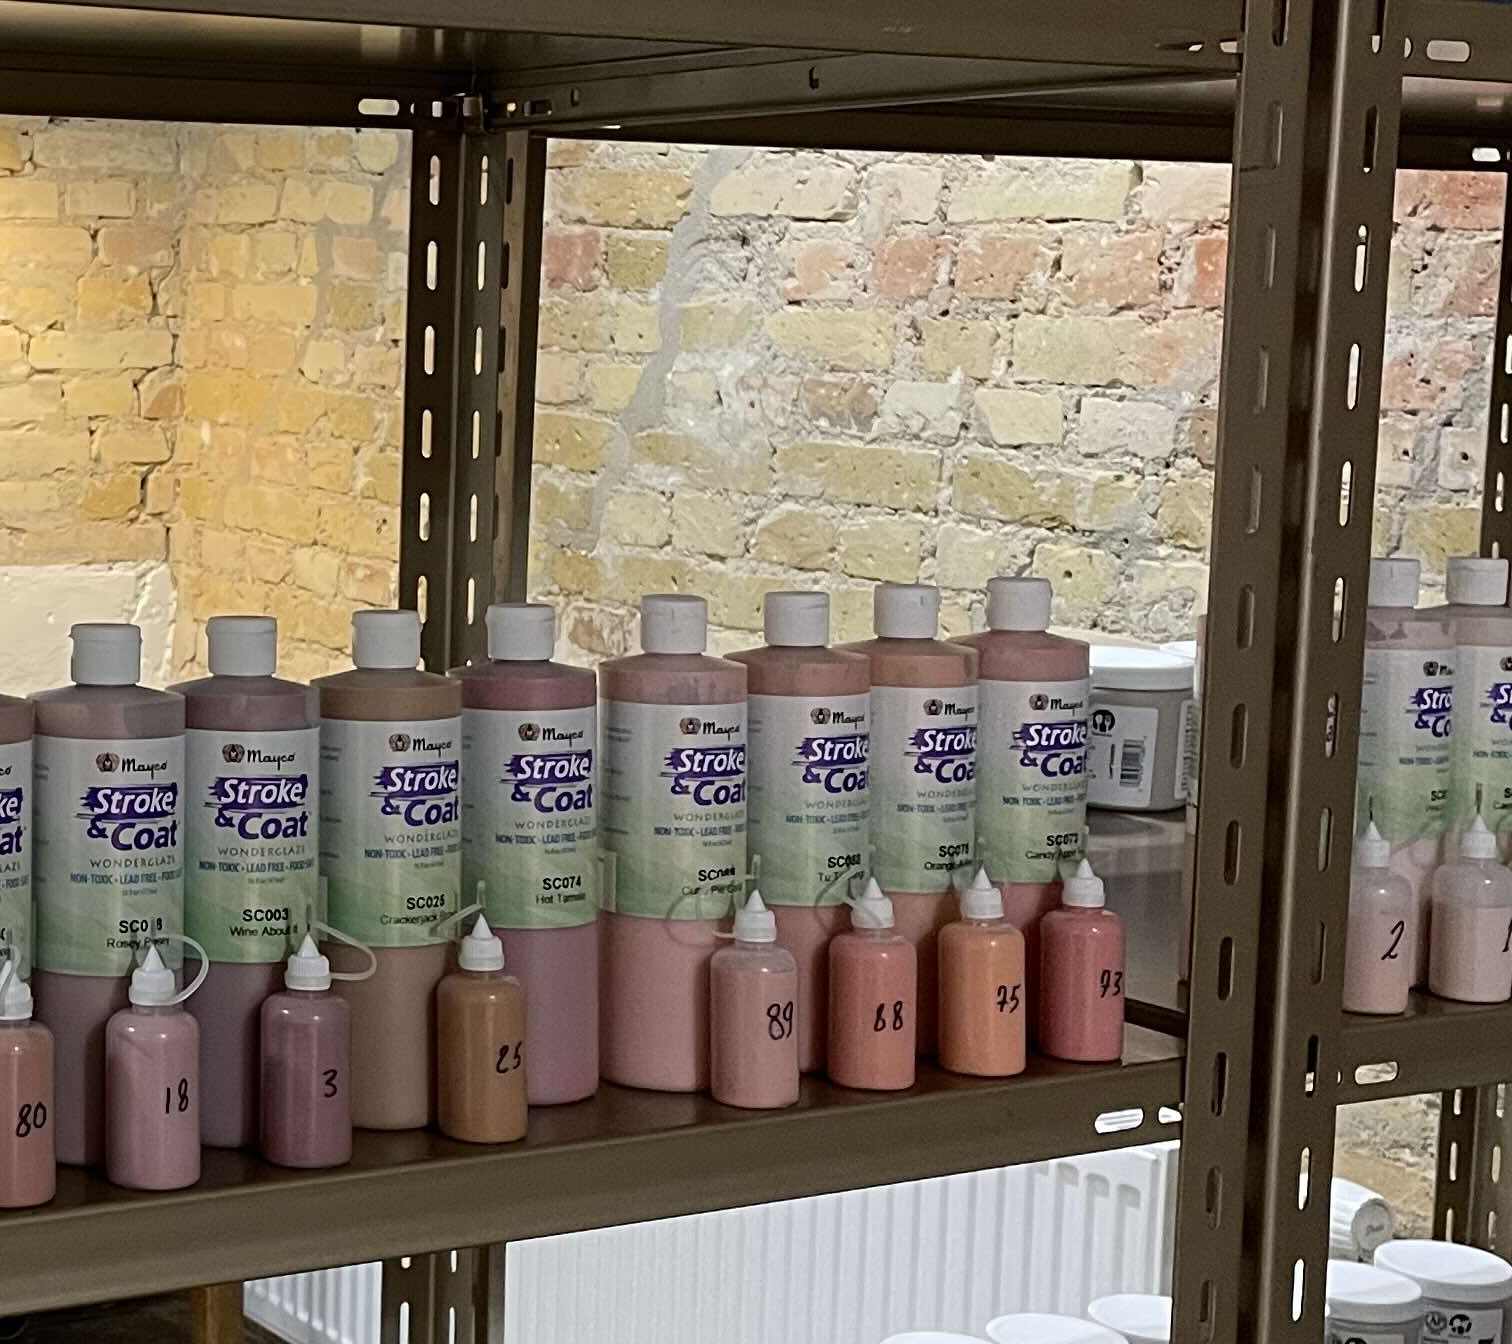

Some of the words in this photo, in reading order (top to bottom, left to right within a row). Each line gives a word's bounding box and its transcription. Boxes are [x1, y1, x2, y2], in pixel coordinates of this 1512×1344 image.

[542, 727, 584, 747] Mayco
[702, 721, 740, 741] Mayco
[1025, 724, 1087, 746] Stroke
[247, 749, 296, 771] Mayco
[412, 738, 453, 757] Mayco
[121, 758, 169, 780] Mayco
[516, 755, 590, 780] Stroke
[677, 749, 745, 773] Stroke
[1019, 749, 1039, 767] &
[1040, 752, 1088, 777] Coat
[219, 779, 303, 805] Stroke
[386, 767, 457, 793] Stroke
[670, 776, 691, 795] &
[693, 778, 746, 806] Coat
[93, 788, 174, 815] Stroke
[510, 783, 532, 803] &
[533, 785, 593, 813] Coat
[214, 808, 236, 828] &
[237, 811, 309, 840] Coat
[380, 797, 402, 817] &
[404, 798, 459, 827] Coat
[86, 819, 108, 840] &
[111, 819, 178, 851] Coat
[542, 875, 582, 891] SC074
[242, 907, 289, 923] SC003
[406, 894, 446, 910] SC025
[118, 917, 164, 934] SC08
[230, 925, 259, 937] Wine
[1380, 920, 1405, 961] 2
[996, 984, 1020, 1013] 75
[766, 1000, 794, 1041] 89
[164, 1078, 189, 1114] 18
[322, 1069, 339, 1098] 3
[15, 1102, 47, 1138] 80
